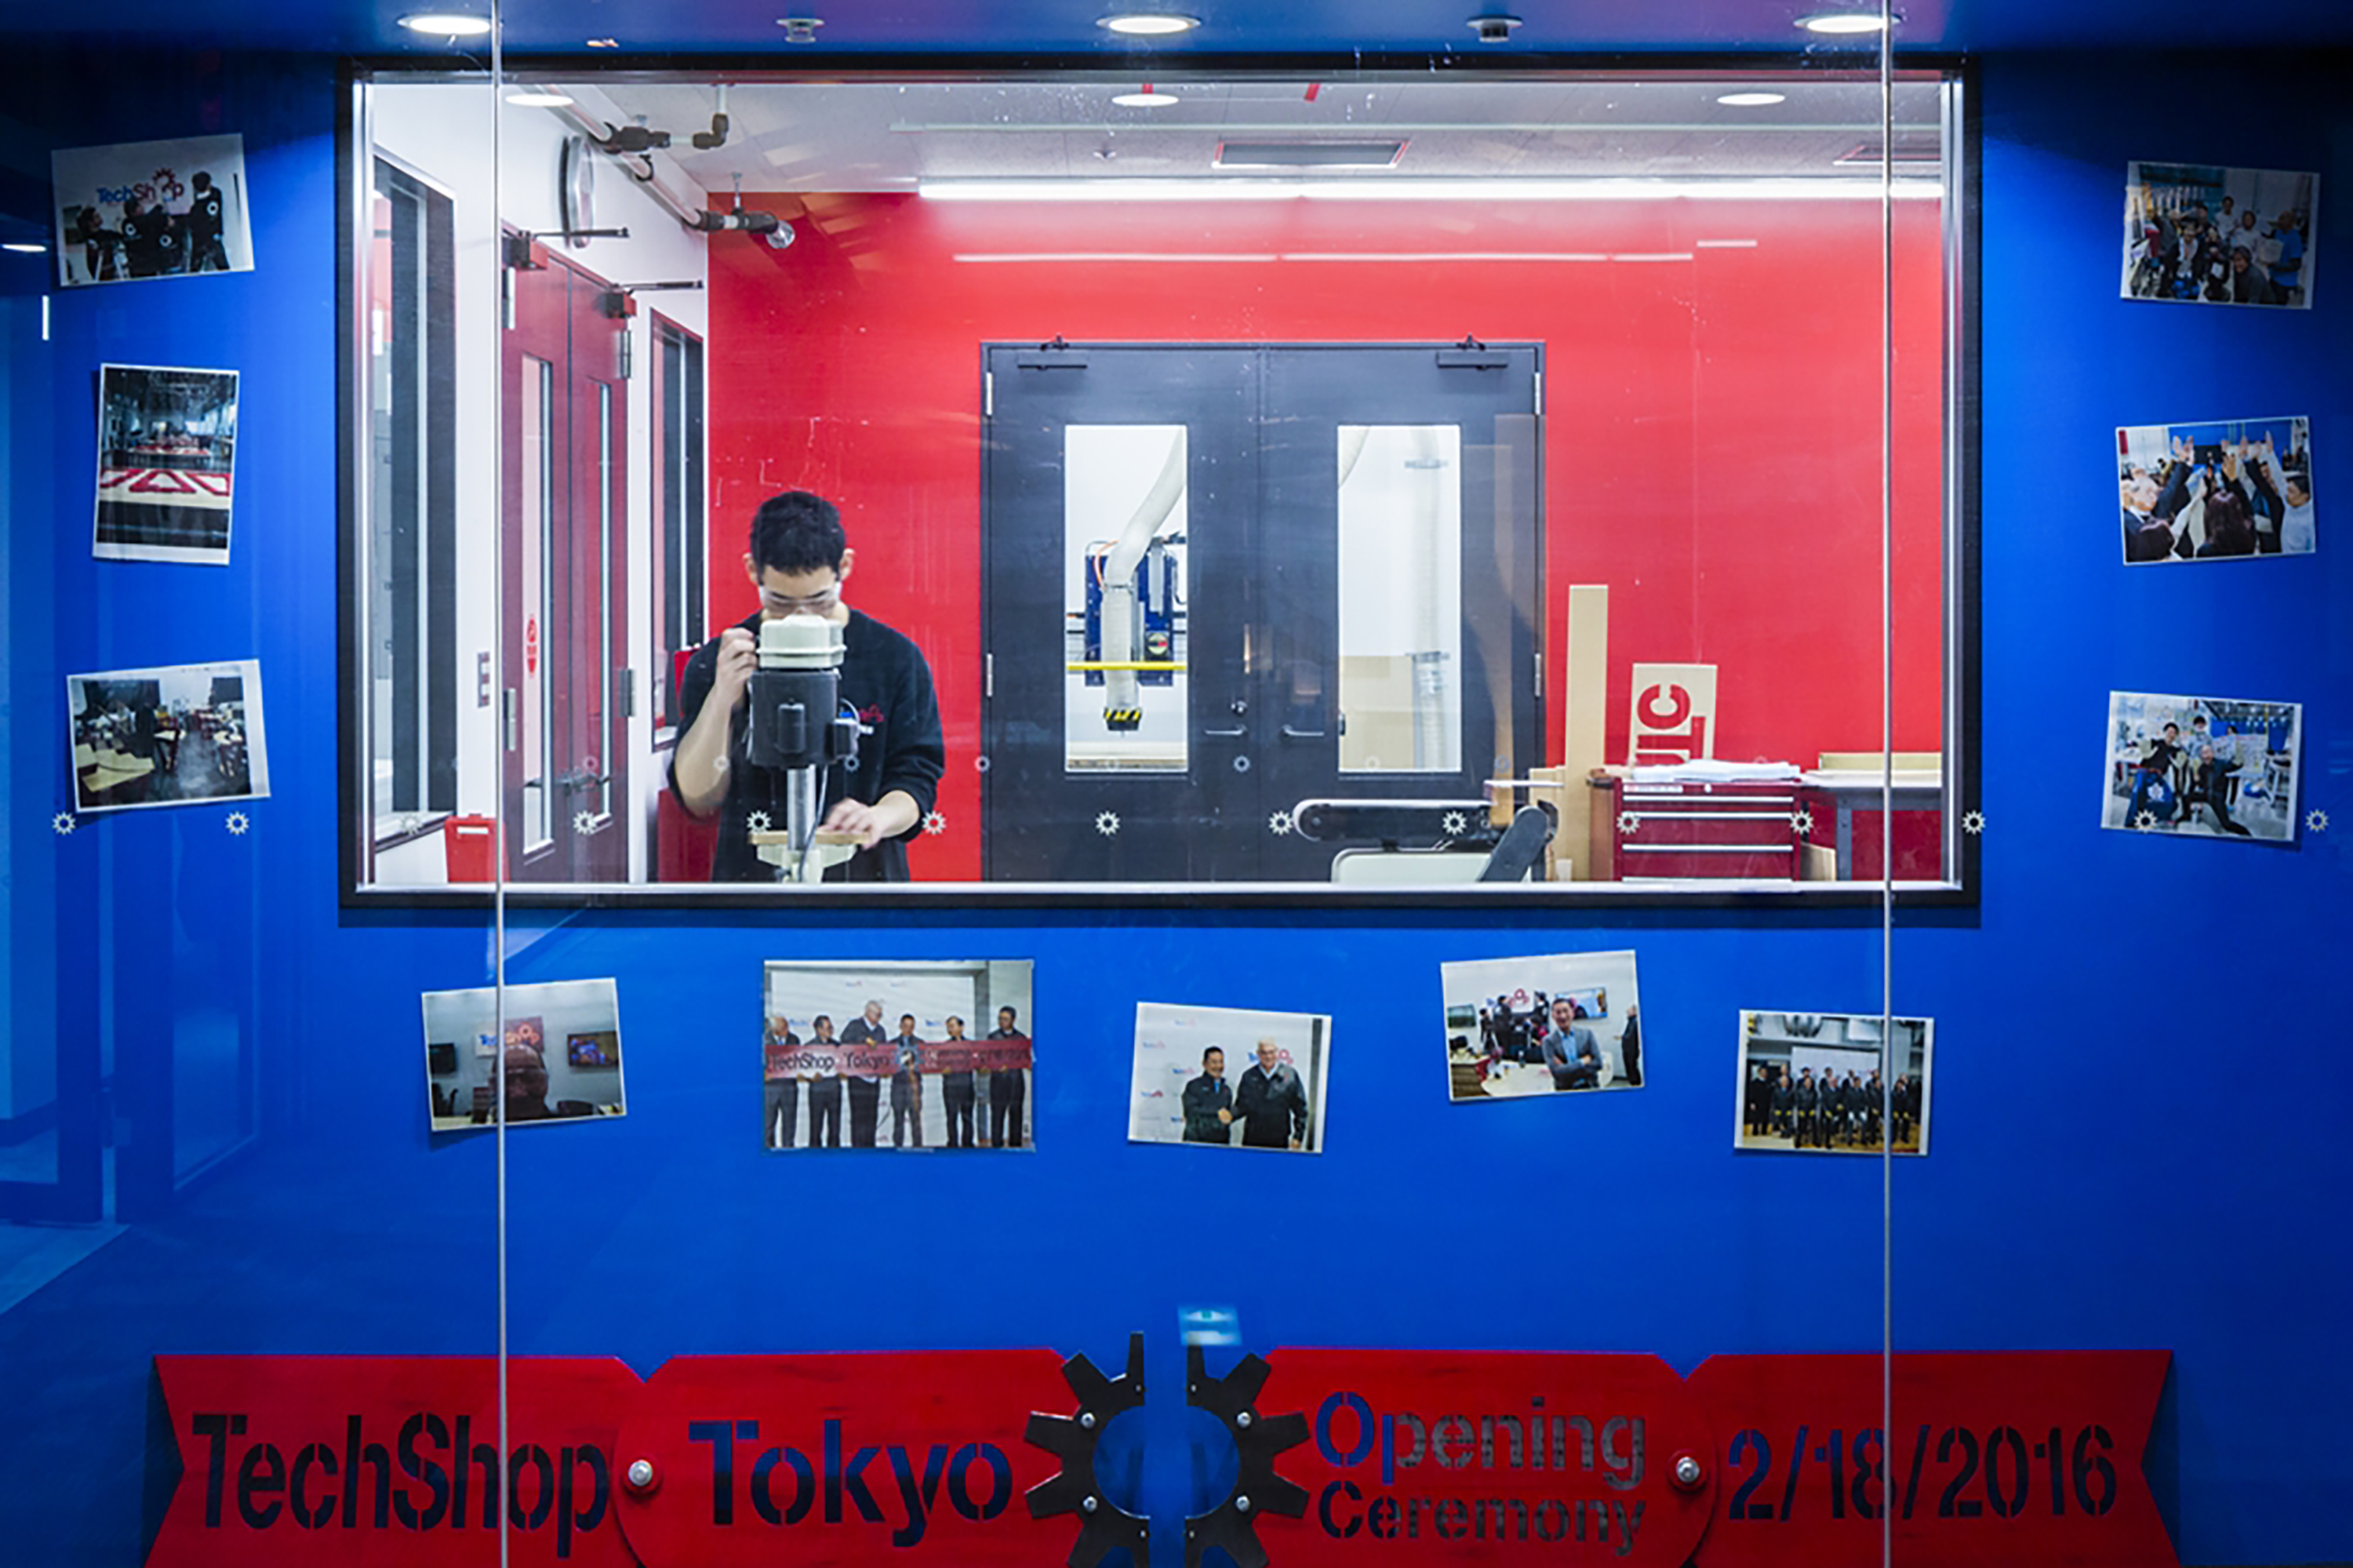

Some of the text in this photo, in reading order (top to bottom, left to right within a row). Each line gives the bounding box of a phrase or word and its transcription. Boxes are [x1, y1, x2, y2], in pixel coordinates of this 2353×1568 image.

[192, 1412, 1013, 1559] TechShop Tokyo
[1315, 1391, 1646, 1492] Opening
[1728, 1424, 2118, 1522] 2/18/2016
[1318, 1479, 1646, 1558] Ceremony
